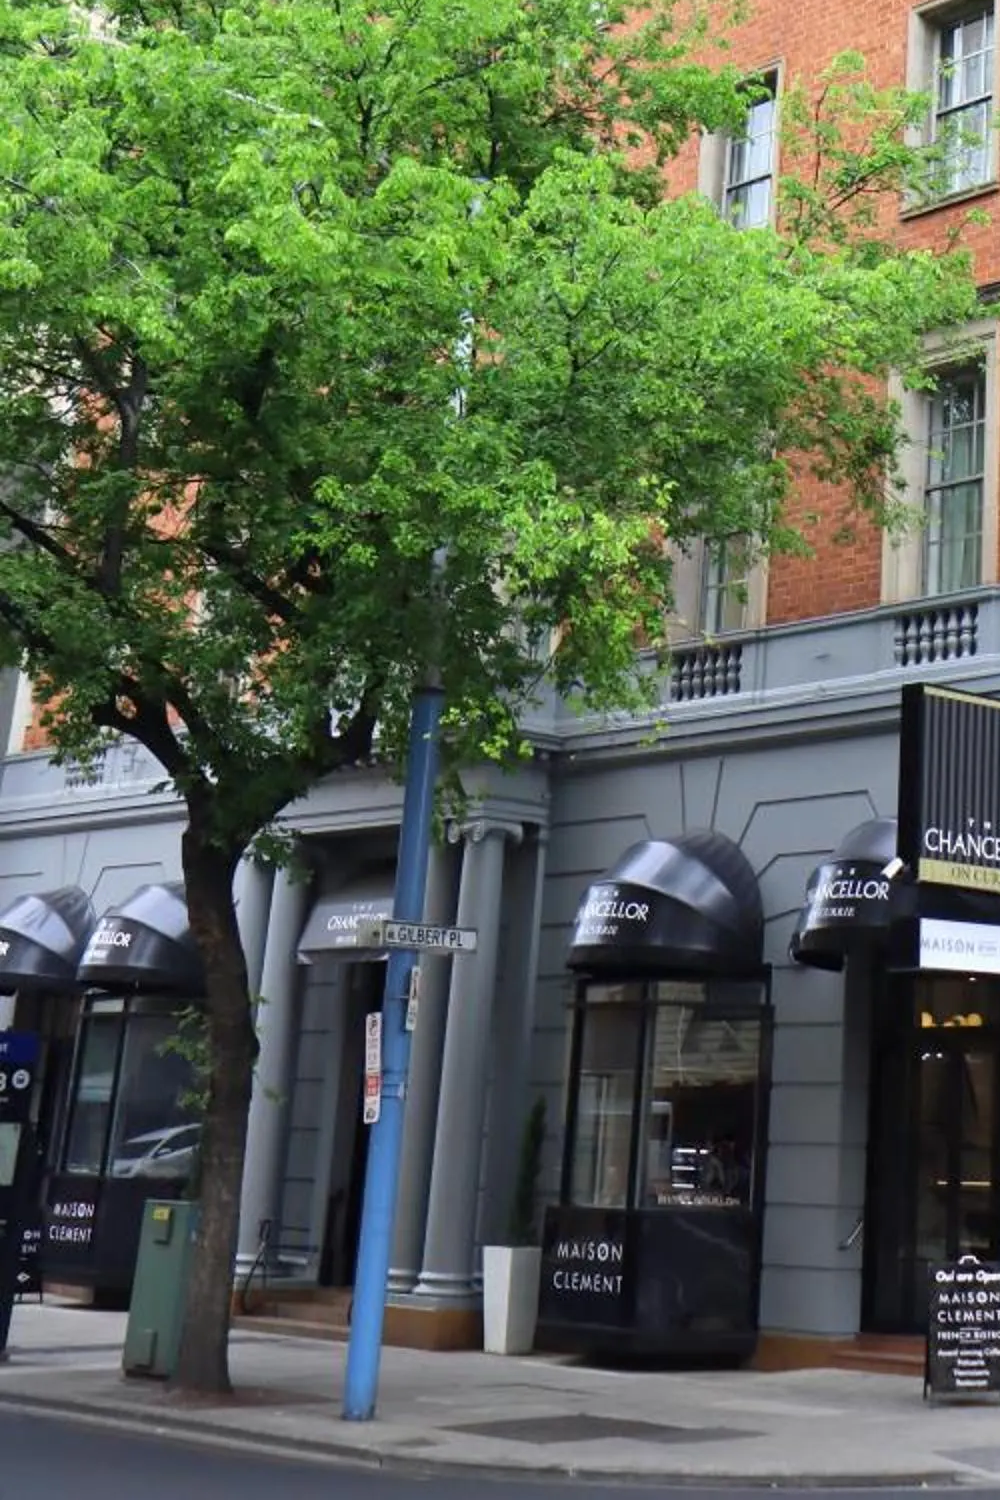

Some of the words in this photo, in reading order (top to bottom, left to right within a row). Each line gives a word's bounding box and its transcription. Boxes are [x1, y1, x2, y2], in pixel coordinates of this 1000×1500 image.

[951, 867, 971, 881] ON
[400, 927, 445, 946] GILBERT
[450, 931, 463, 947] PL
[921, 937, 975, 955] MAISON
[53, 1202, 95, 1217] MAISON
[49, 1225, 92, 1242] CLEMENT
[557, 1241, 623, 1261] MAISON
[553, 1271, 623, 1293] CLEMENT
[936, 1270, 955, 1282] Oui
[956, 1273, 973, 1282] are
[939, 1291, 1000, 1304] MAISON
[937, 1331, 970, 1340] FRENCH
